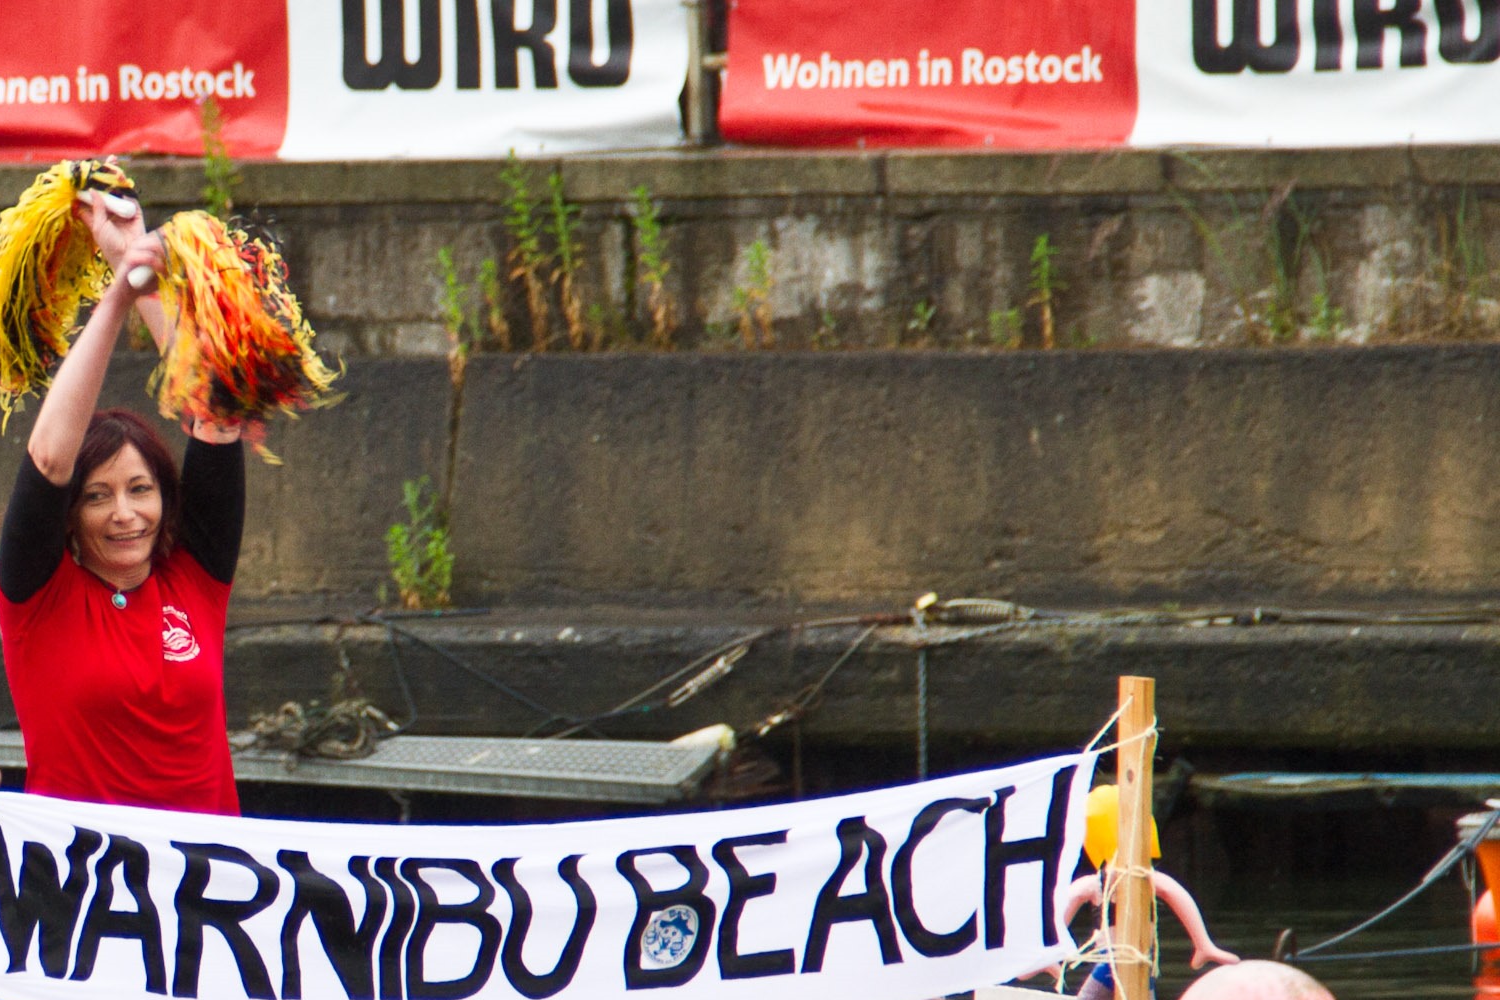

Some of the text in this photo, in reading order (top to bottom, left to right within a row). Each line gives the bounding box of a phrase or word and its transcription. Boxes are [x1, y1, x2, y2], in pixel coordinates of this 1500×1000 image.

[77, 66, 110, 102] in
[118, 62, 256, 100] Rostock
[762, 46, 1103, 90] Wohnen in Rostock
[615, 764, 1080, 991] BEACH
